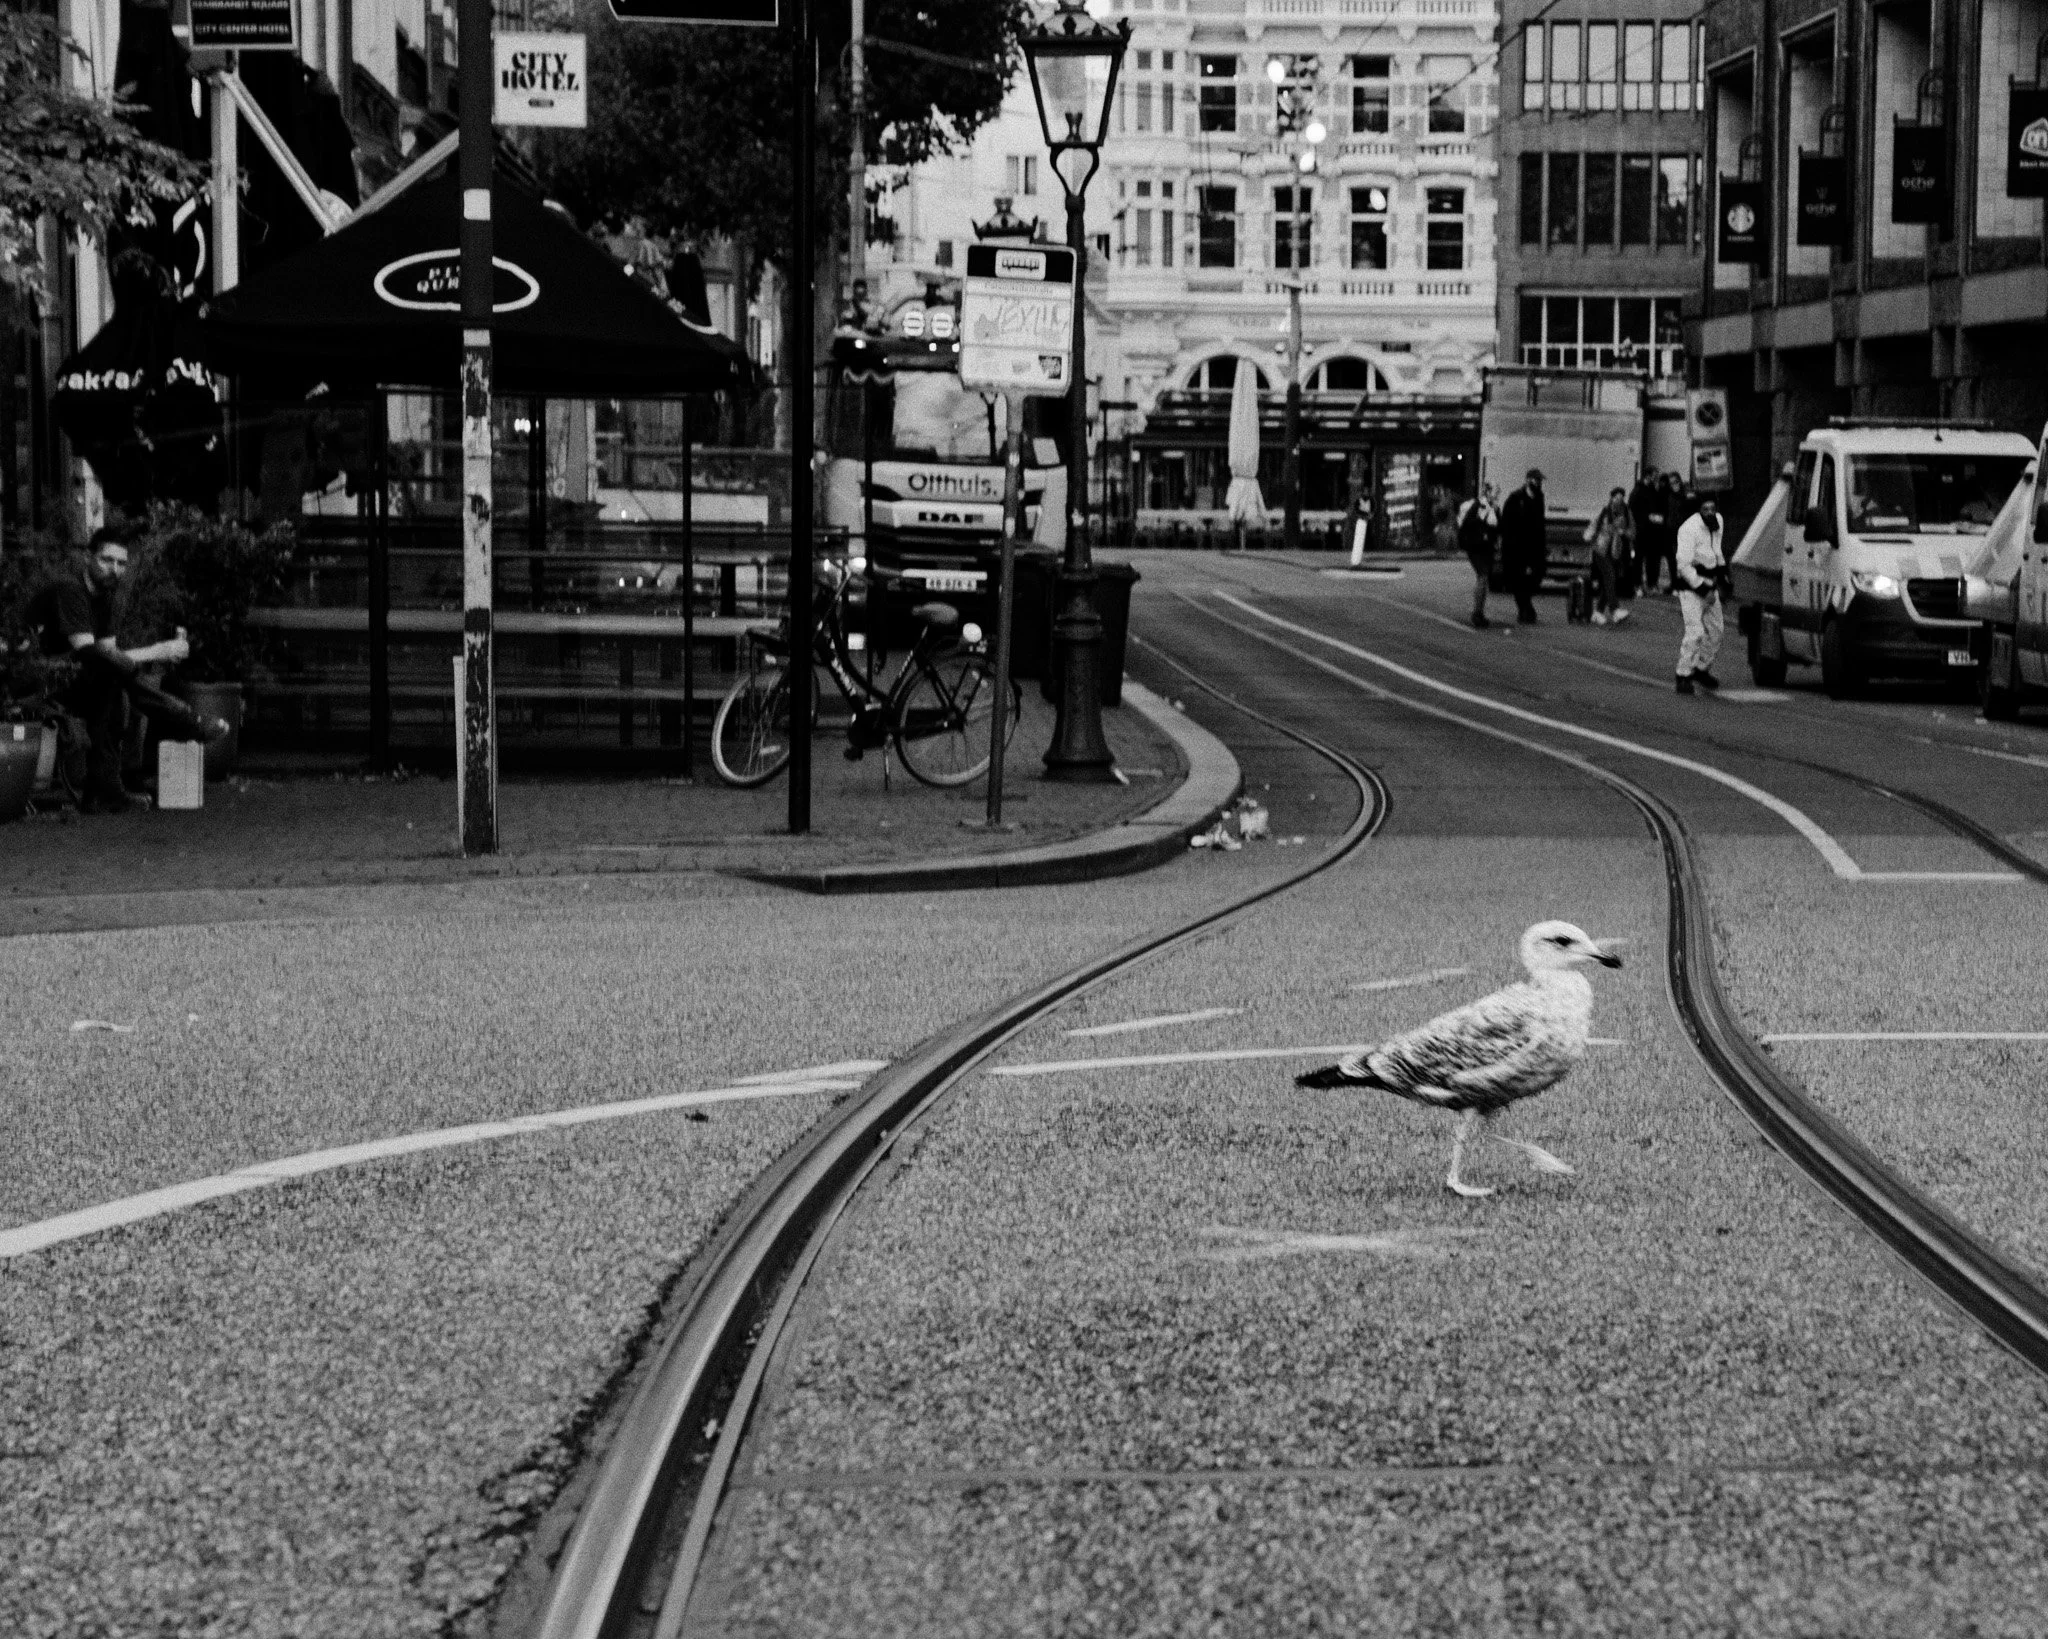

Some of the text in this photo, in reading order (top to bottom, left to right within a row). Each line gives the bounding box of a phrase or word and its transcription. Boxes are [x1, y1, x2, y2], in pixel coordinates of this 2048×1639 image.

[195, 23, 289, 34] CITY CENTER HOTEL
[511, 51, 567, 77] CITY
[502, 69, 579, 92] HOTEL
[918, 511, 984, 524] DAF
